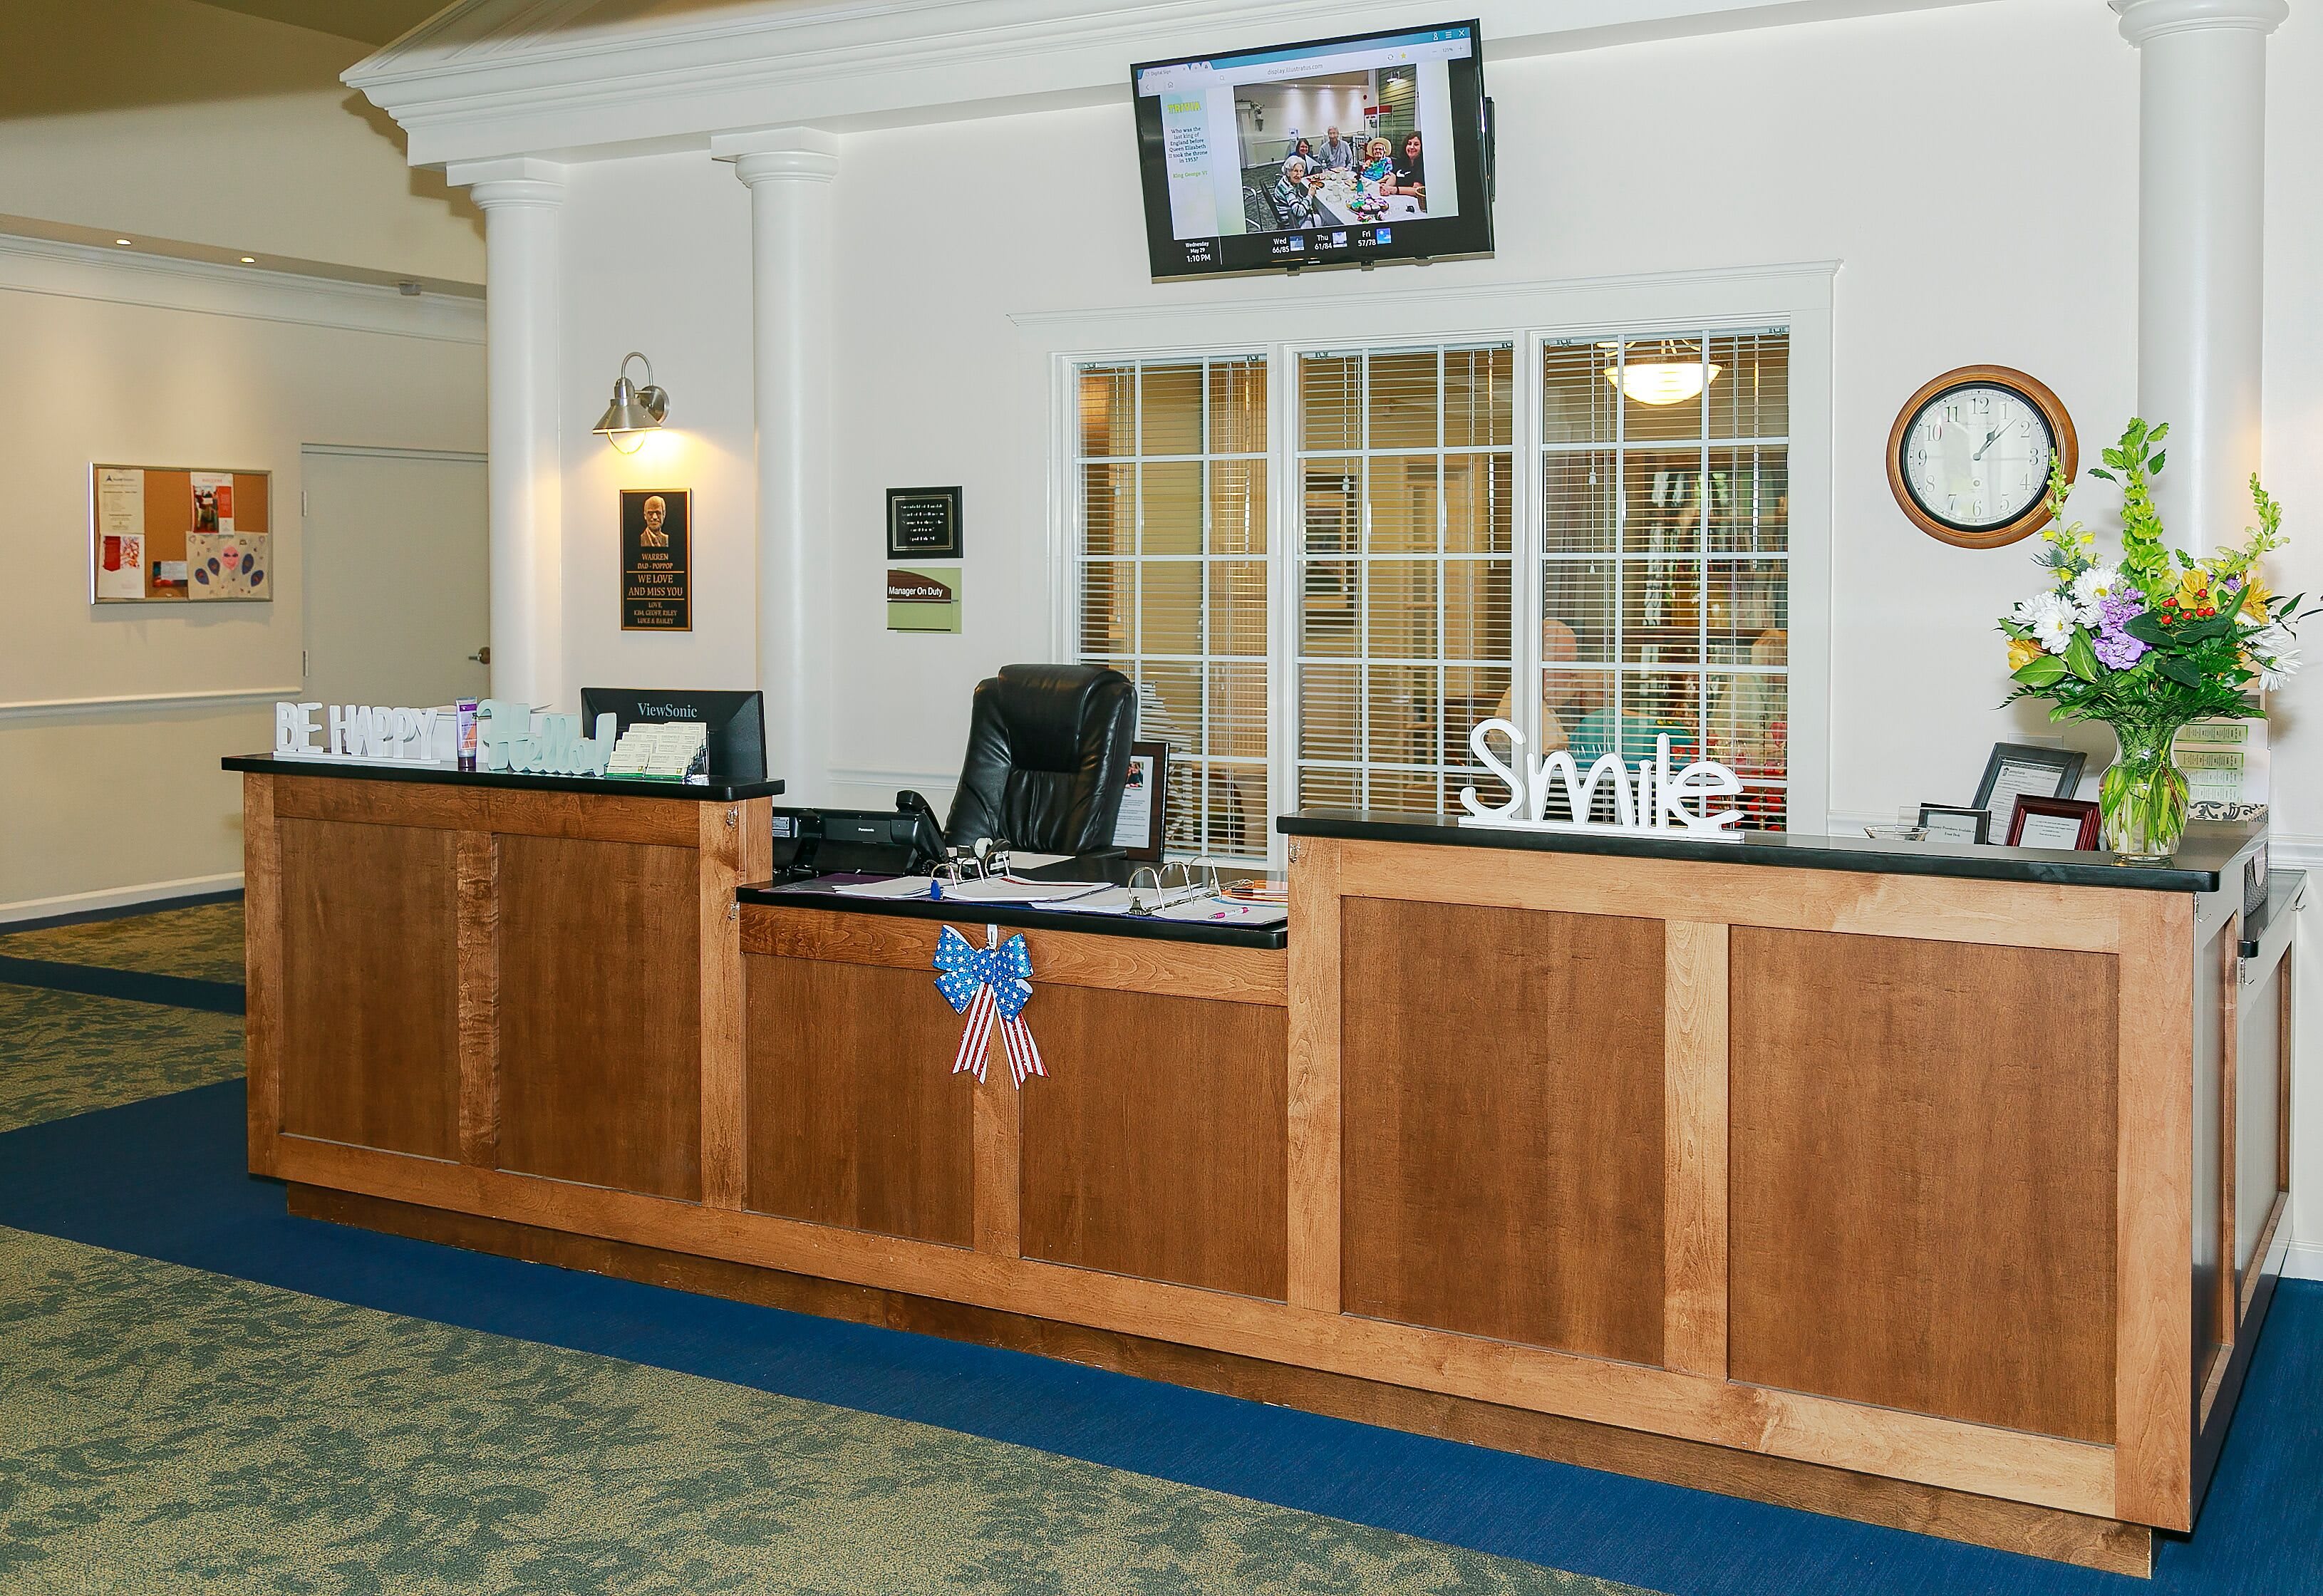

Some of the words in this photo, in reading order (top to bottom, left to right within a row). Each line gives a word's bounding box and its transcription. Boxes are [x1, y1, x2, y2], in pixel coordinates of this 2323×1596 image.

[1267, 63, 1323, 75] display.illustratus.com
[1167, 102, 1201, 114] TRIVIA
[1945, 405, 1960, 423] 11
[1970, 397, 1989, 415] 12
[2002, 403, 2009, 420] 1
[1925, 424, 1942, 441] 10
[2020, 421, 2030, 438] 2
[1918, 450, 1928, 466] 9
[2029, 448, 2039, 465] 3
[1925, 475, 1935, 492] 8
[2019, 473, 2030, 491] 4
[1947, 494, 1957, 511] 7
[1972, 499, 1982, 517] 6
[2000, 493, 2009, 510] 5
[638, 574, 651, 583] WE
[653, 574, 673, 583] LOVE
[628, 587, 646, 596] AND
[647, 587, 666, 596] MISS
[667, 587, 683, 596] YOU
[889, 586, 916, 596] Manager
[928, 587, 943, 597] Duty
[637, 703, 698, 717] ViewSonic
[276, 702, 324, 753] BE
[328, 704, 438, 760] HAPPY
[1460, 718, 1744, 829] Smile
